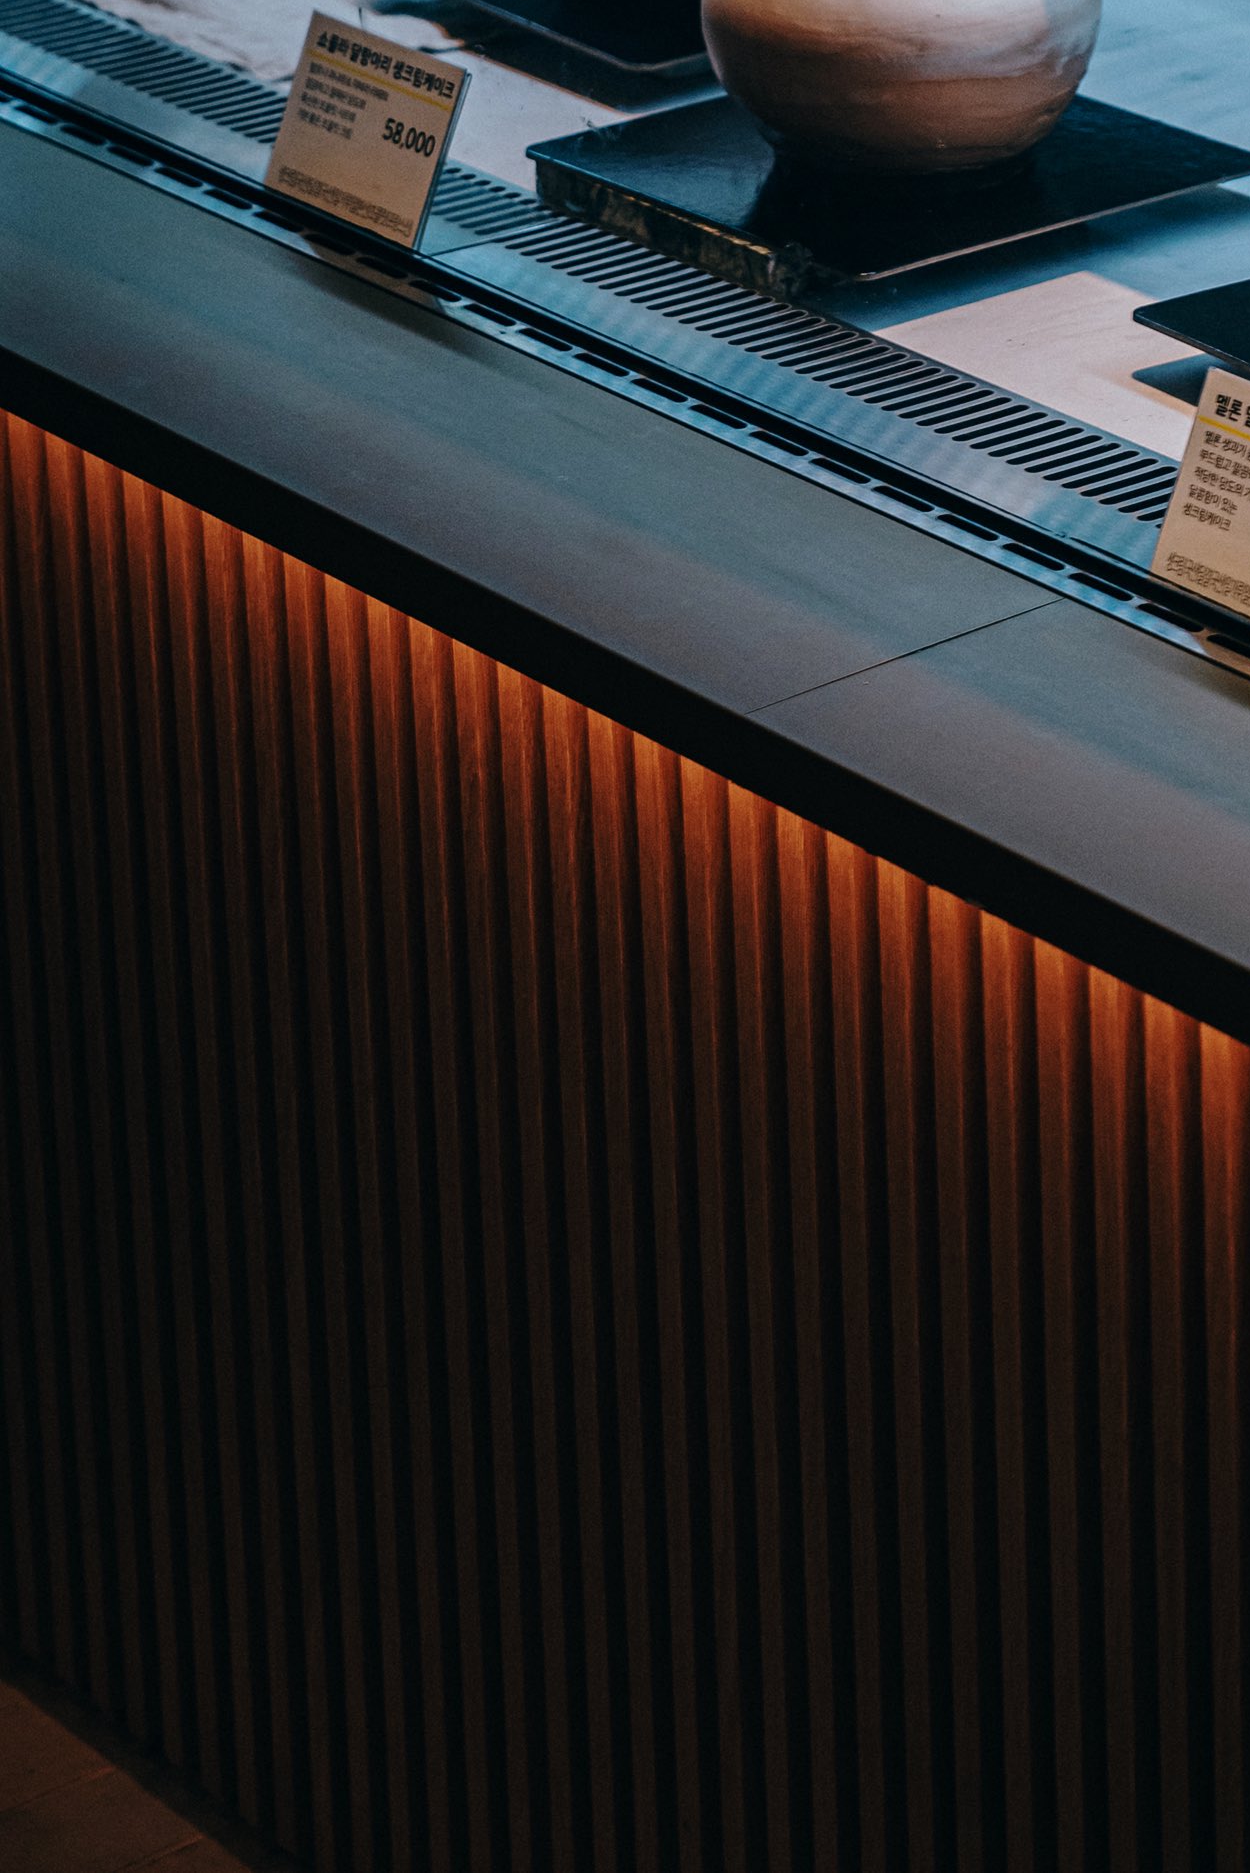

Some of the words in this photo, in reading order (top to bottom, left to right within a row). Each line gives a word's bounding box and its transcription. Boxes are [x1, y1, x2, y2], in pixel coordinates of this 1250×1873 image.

[393, 58, 456, 99] 생크림케이크
[382, 117, 436, 157] 58,000
[1215, 394, 1242, 422] 멜론
